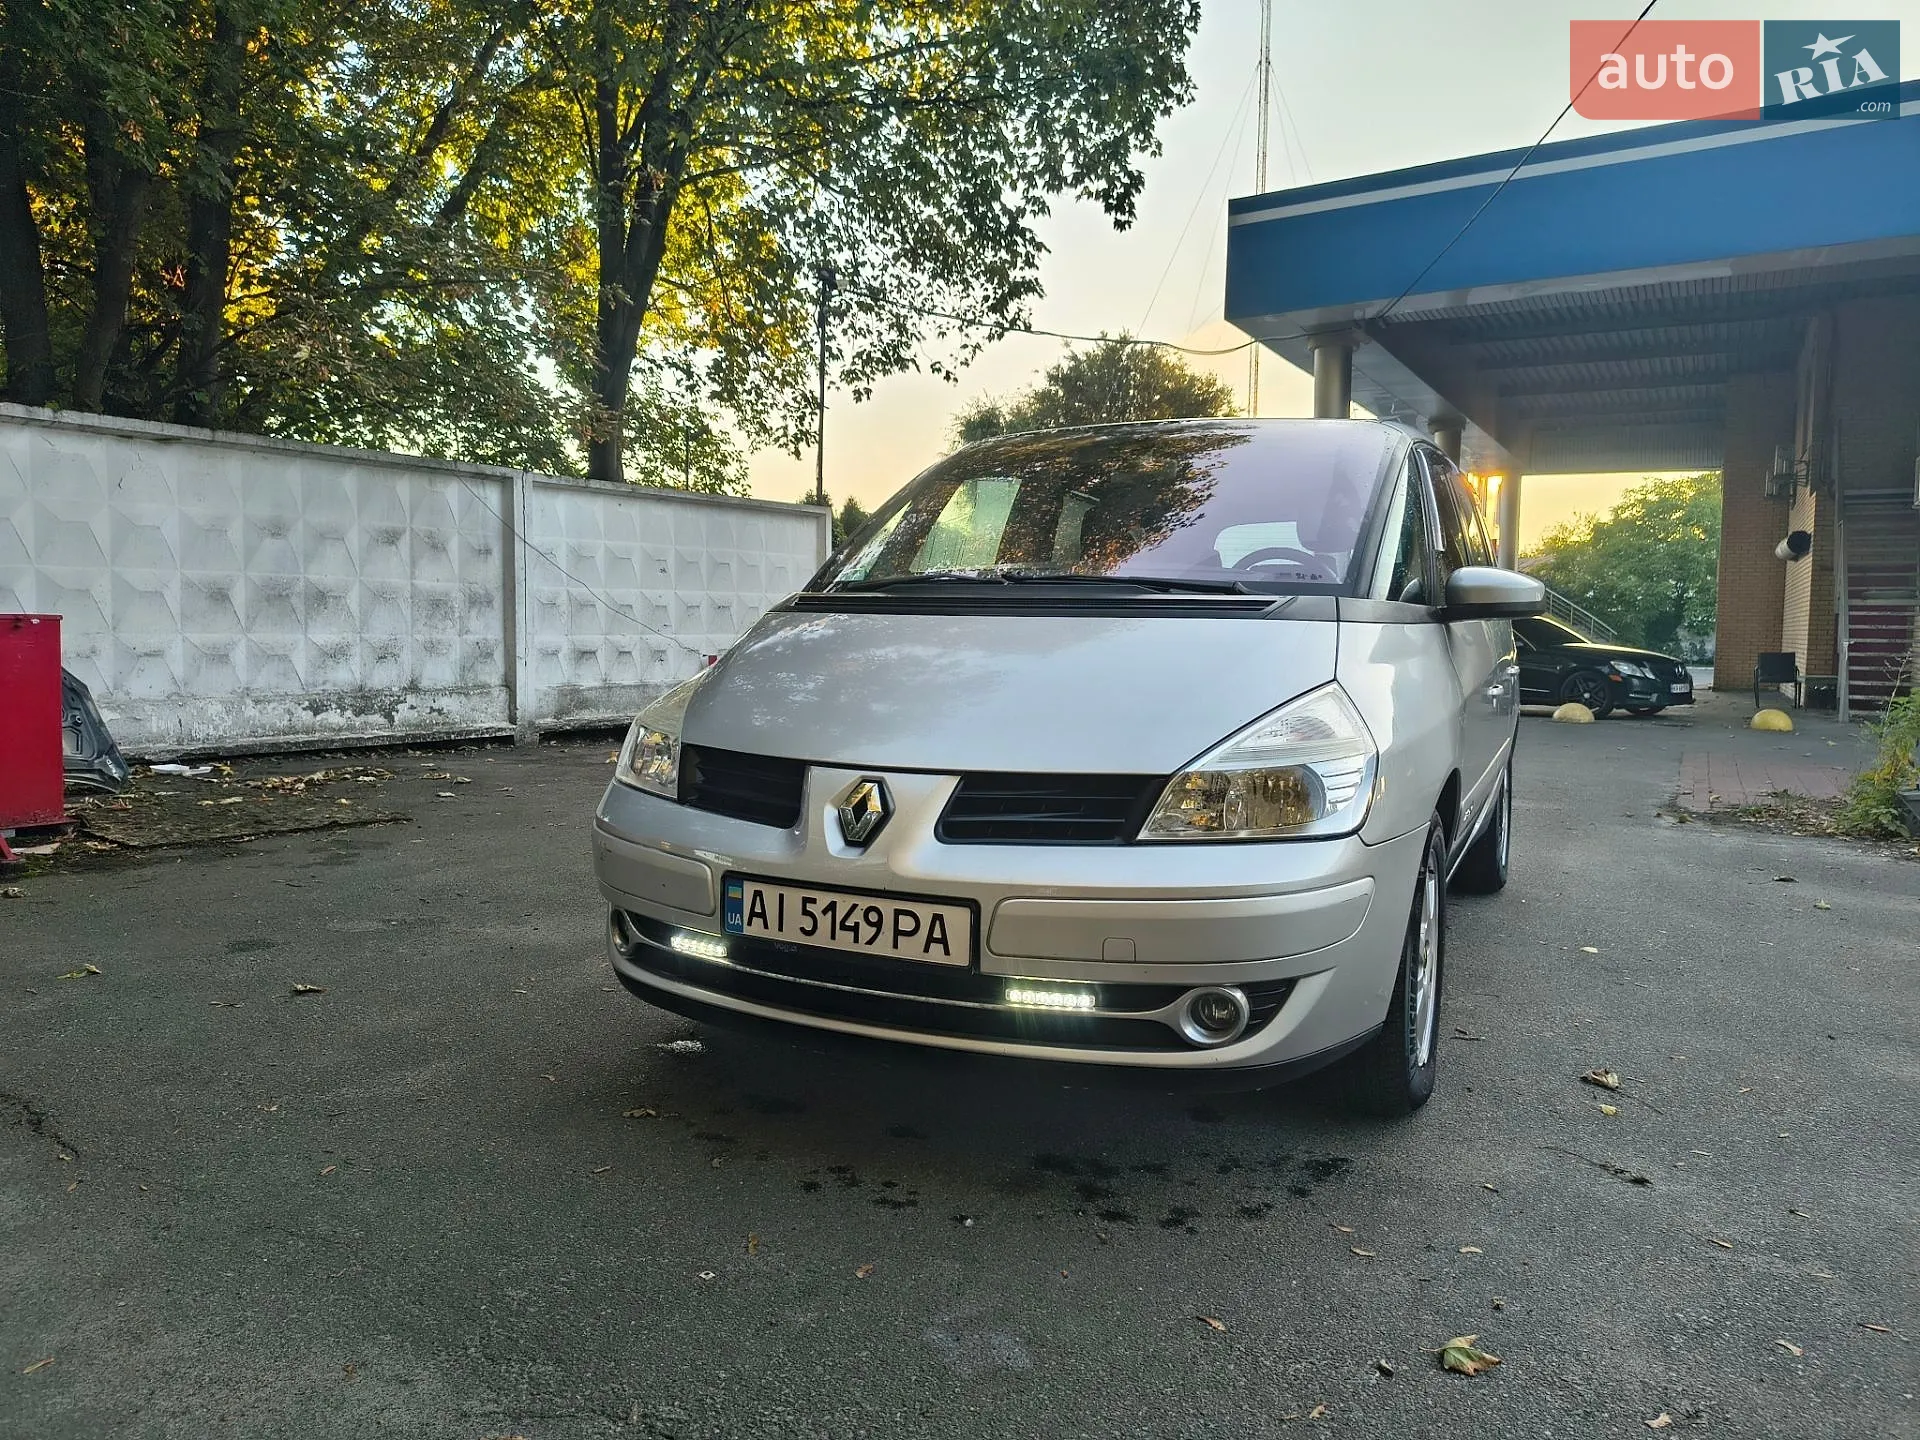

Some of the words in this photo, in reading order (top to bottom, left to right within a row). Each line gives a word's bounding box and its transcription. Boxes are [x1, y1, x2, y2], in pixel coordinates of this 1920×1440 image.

[727, 912, 742, 926] UA
[747, 889, 784, 932] AI
[799, 896, 884, 945] 5149
